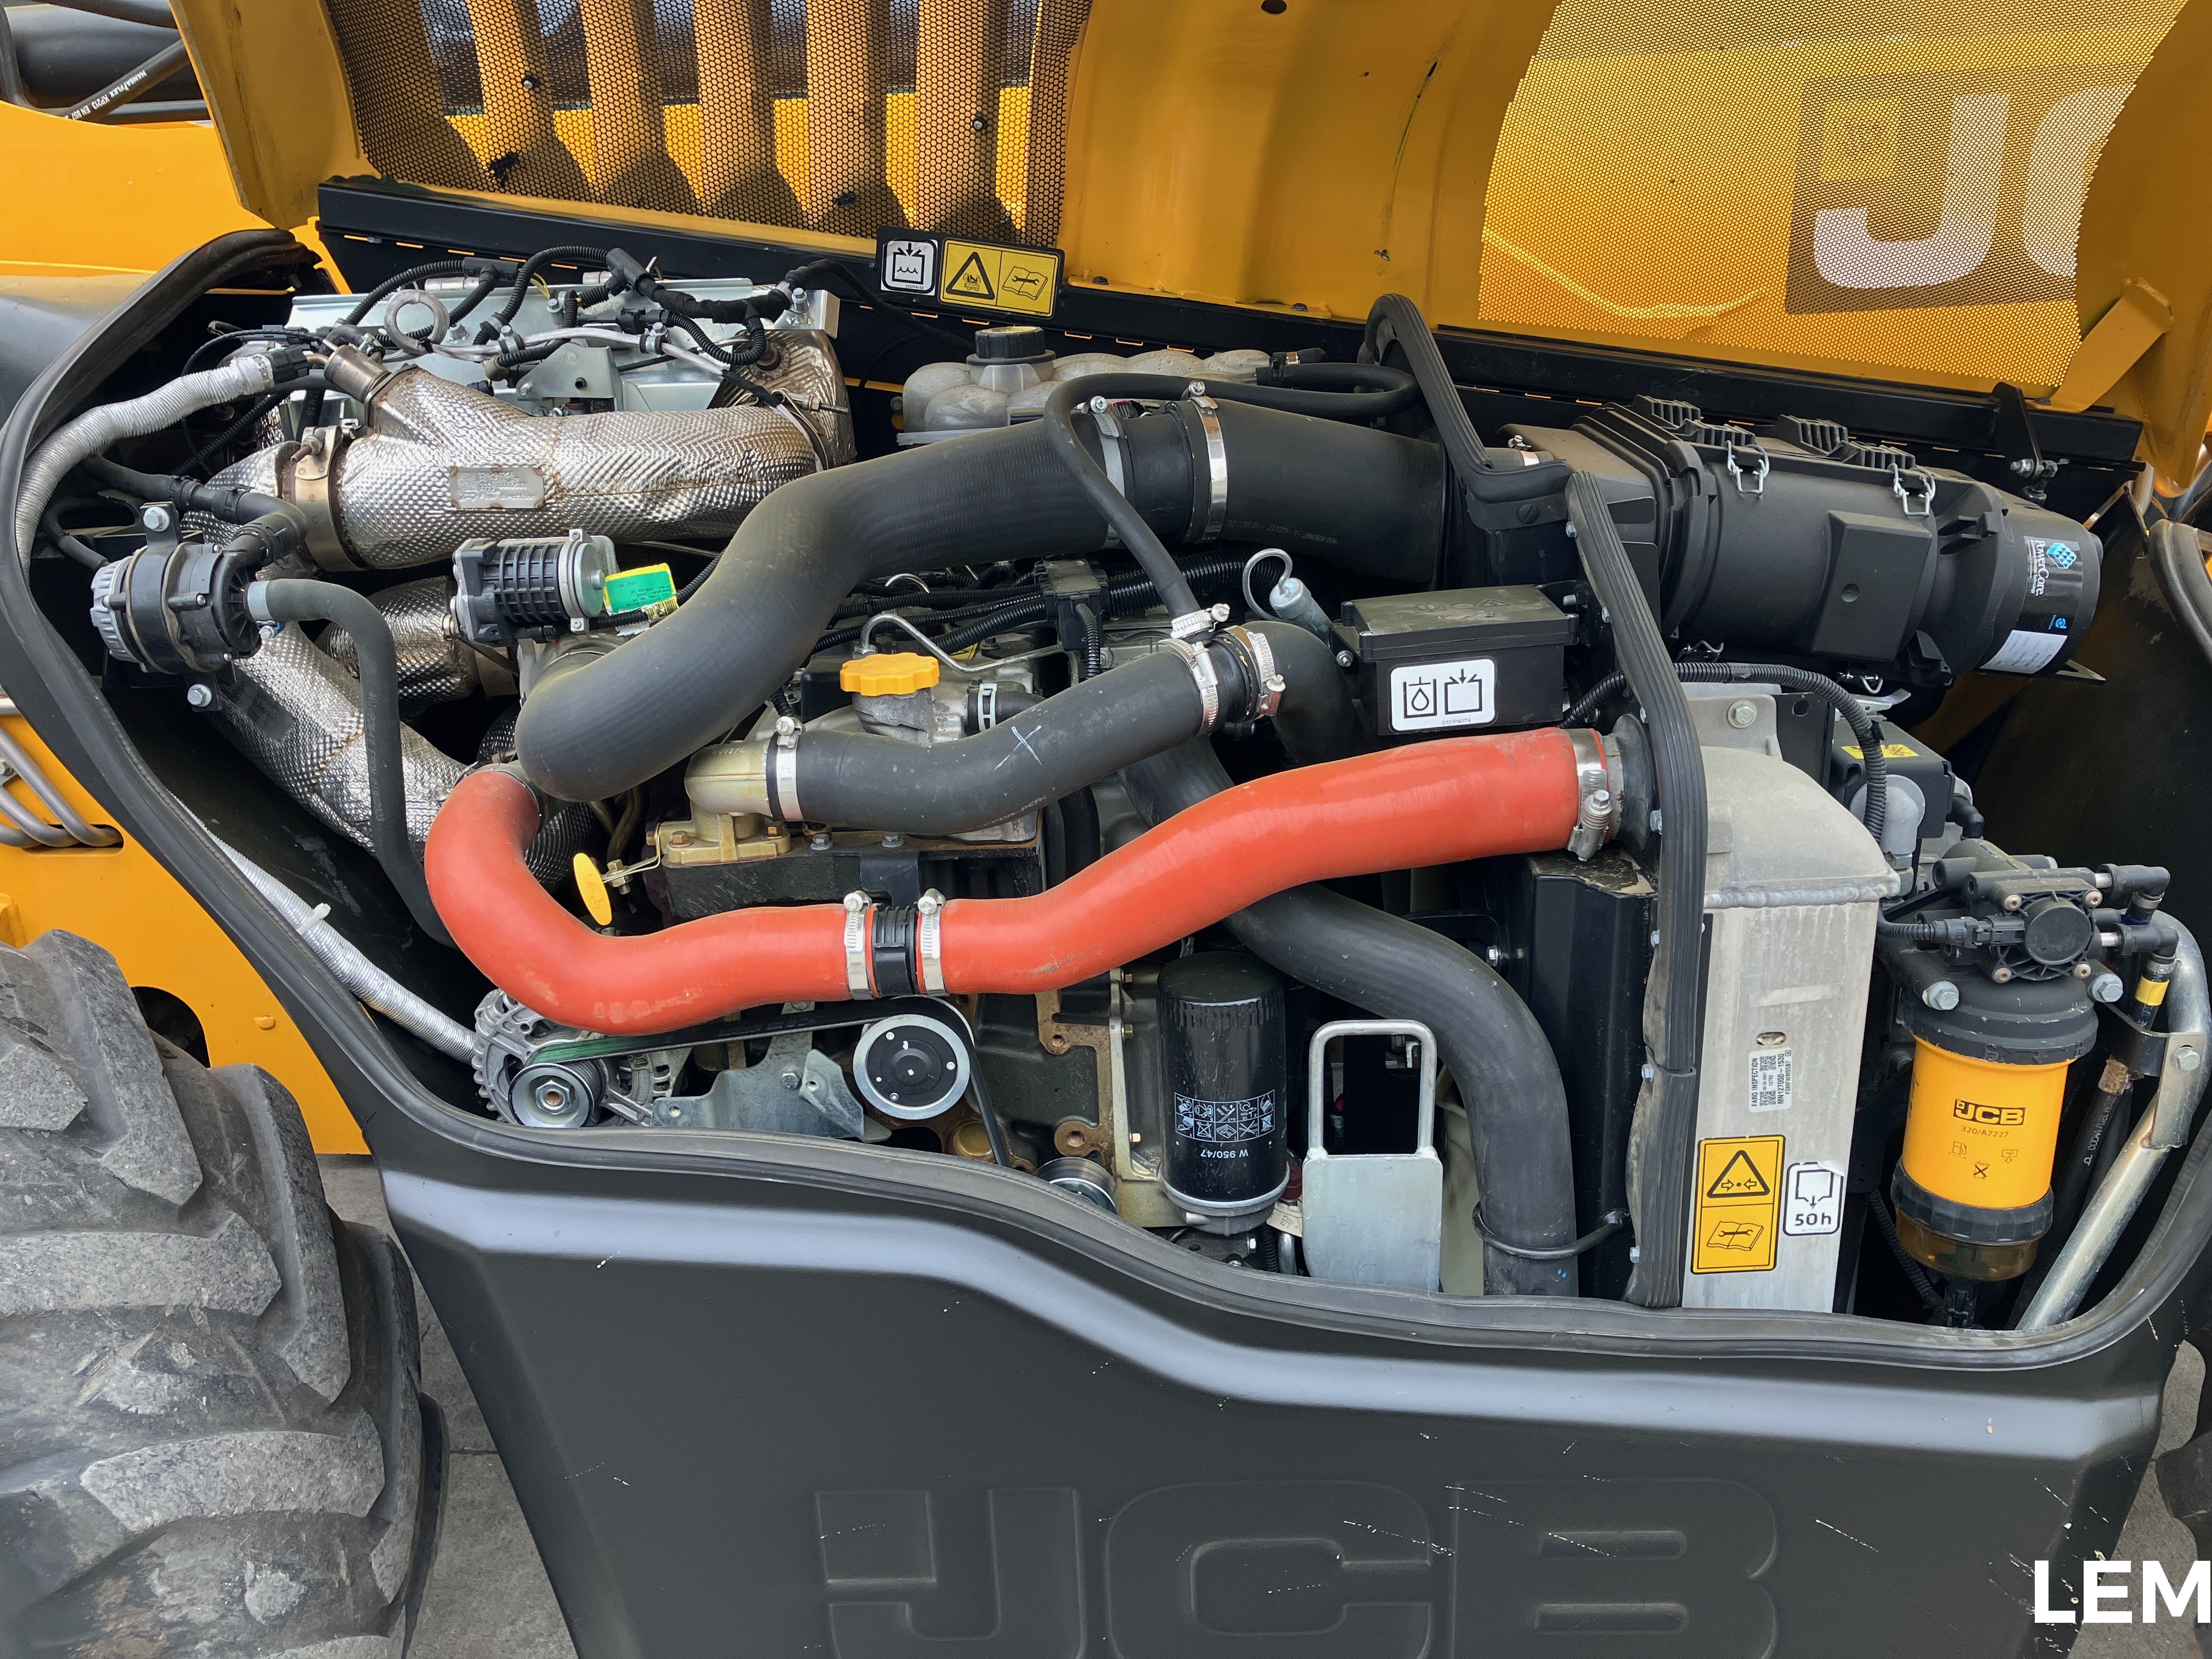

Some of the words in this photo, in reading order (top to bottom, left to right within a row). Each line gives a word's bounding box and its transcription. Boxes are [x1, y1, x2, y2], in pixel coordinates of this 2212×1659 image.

[2034, 539, 2050, 596] PowerCore
[1955, 1100, 2024, 1125] JCB
[1961, 1125, 2009, 1138] 320/A7227
[1200, 1149, 1236, 1159] 950/47
[1239, 1149, 1249, 1157] W
[816, 1480, 1779, 1659] JCB
